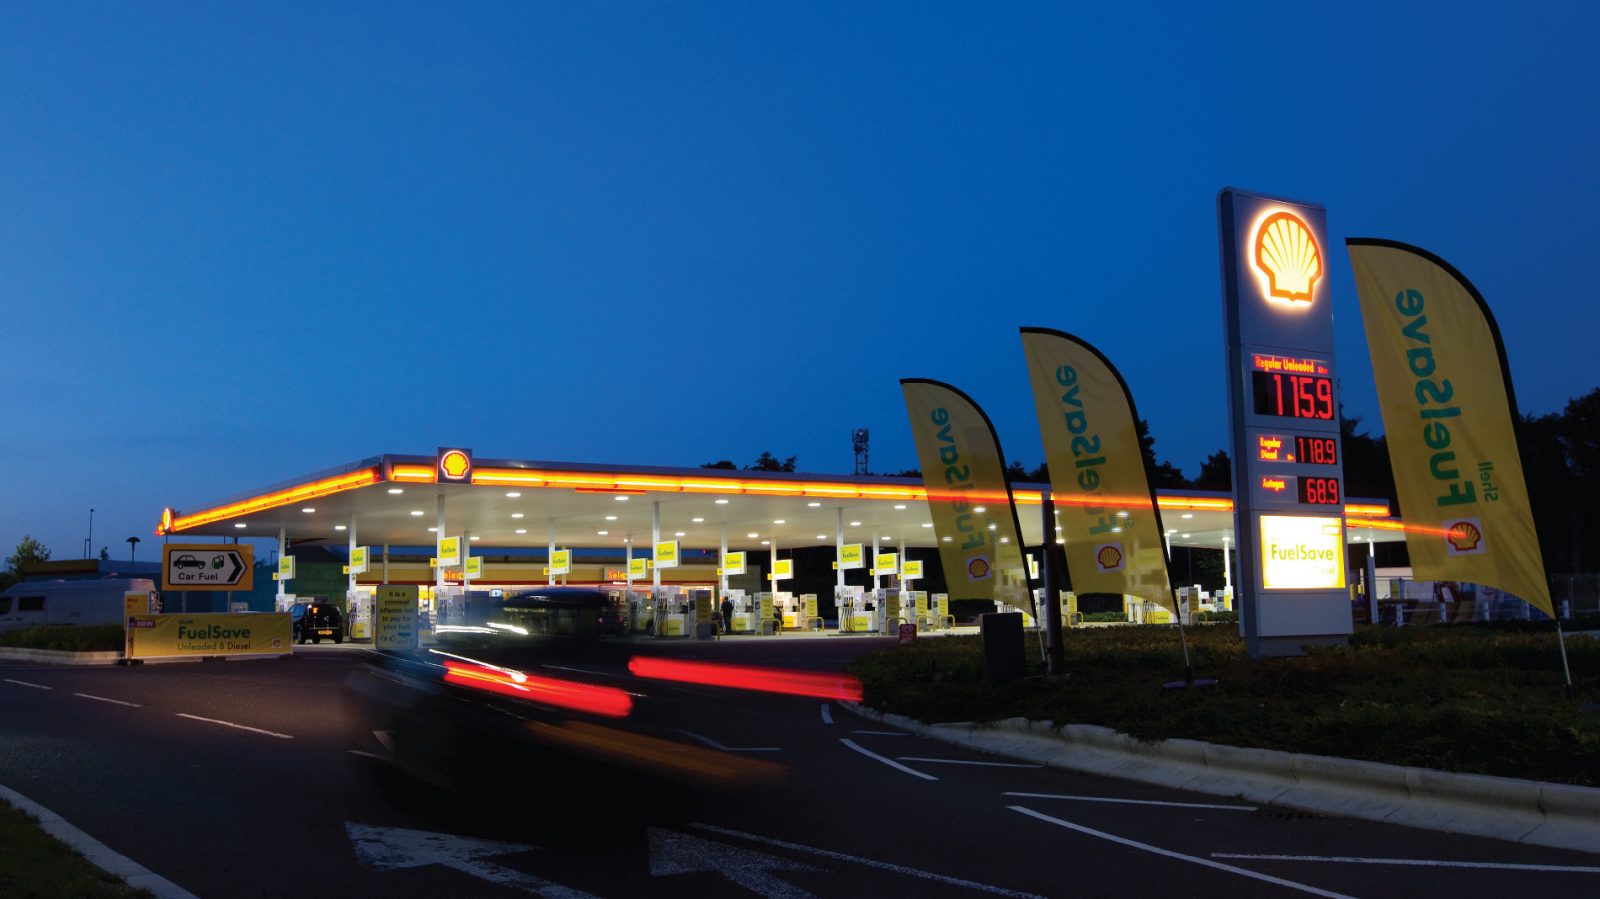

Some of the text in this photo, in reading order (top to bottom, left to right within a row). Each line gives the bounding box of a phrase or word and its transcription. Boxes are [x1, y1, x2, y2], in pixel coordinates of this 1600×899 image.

[1254, 355, 1282, 371] Regular
[1283, 358, 1315, 373] Unleaded
[1274, 374, 1333, 420] 115.9
[1299, 438, 1336, 464] 118.9
[1306, 478, 1338, 505] 68.9
[1271, 544, 1334, 561] FuelSave
[178, 572, 218, 581] Car Fuel
[178, 624, 251, 640] FuelSave
[177, 640, 251, 651] Unleaded & Diesel
